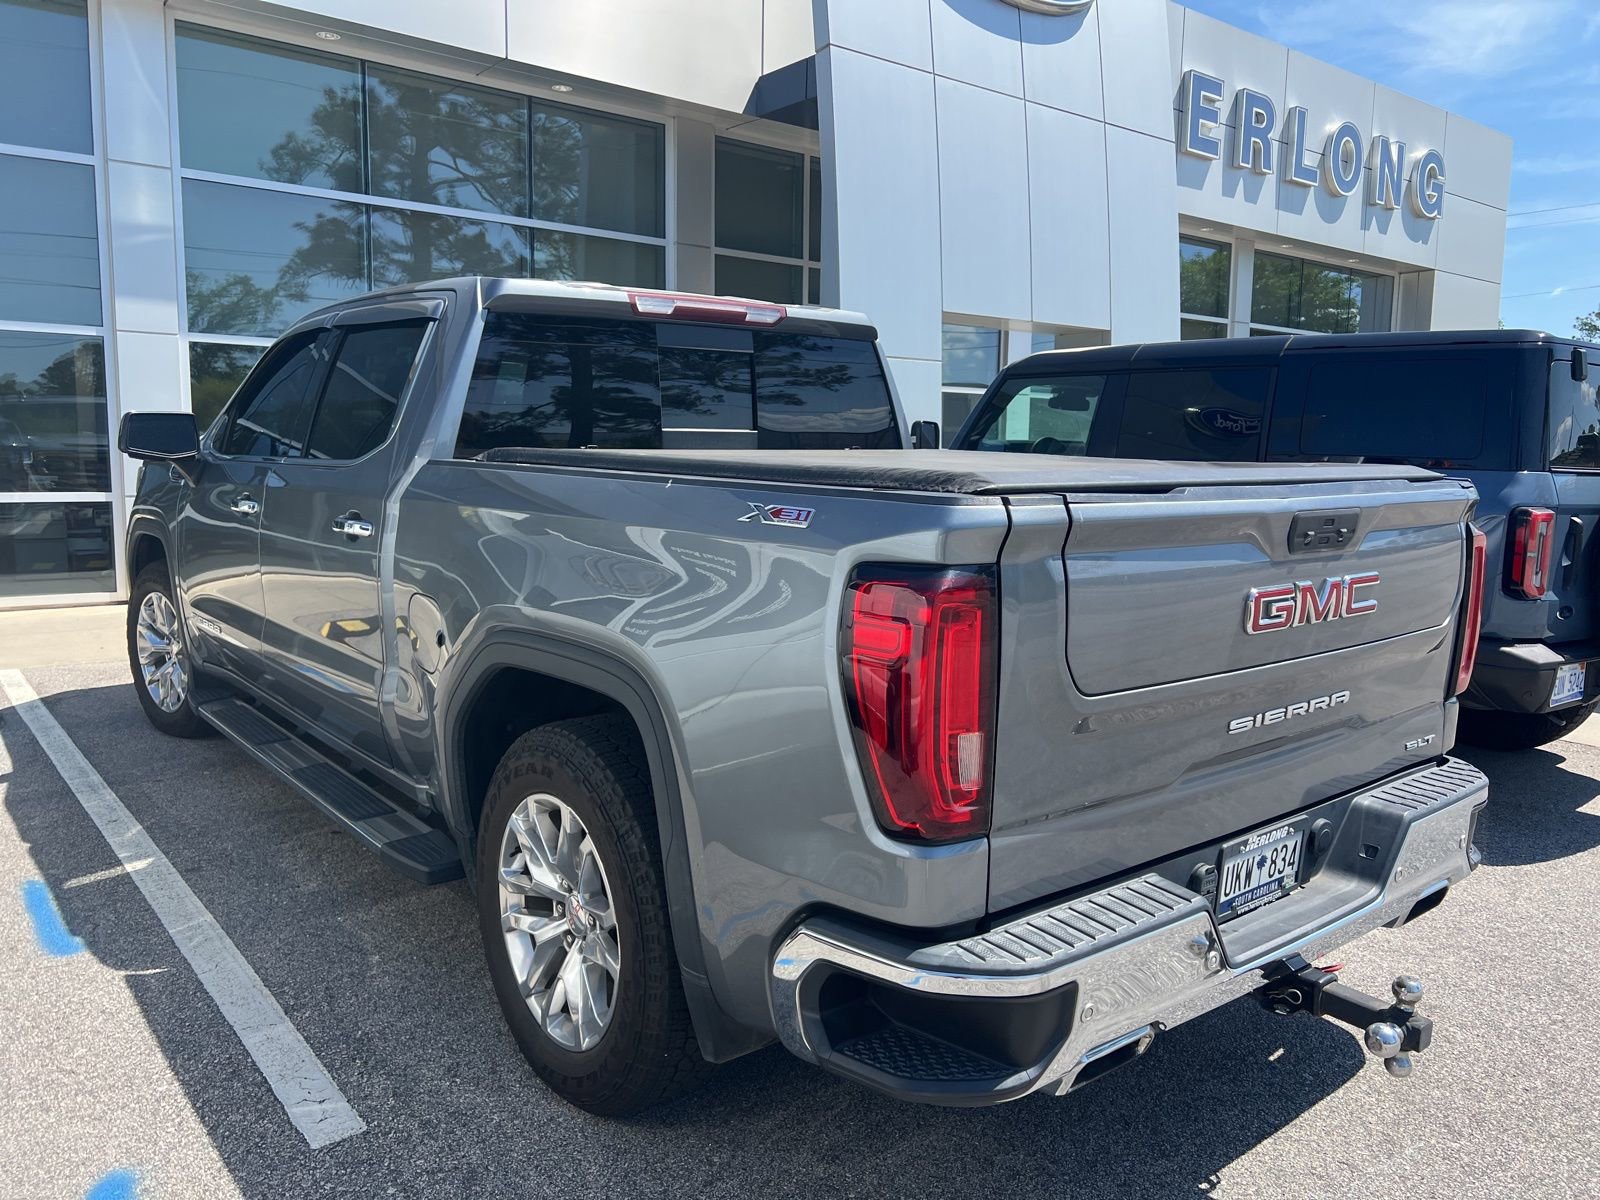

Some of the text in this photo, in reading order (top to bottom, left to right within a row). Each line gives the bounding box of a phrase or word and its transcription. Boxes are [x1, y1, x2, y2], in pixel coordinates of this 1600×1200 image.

[1183, 69, 1446, 219] ERLONG
[1246, 571, 1380, 634] GMC
[1228, 690, 1350, 734] SIERRA
[1405, 735, 1436, 751] SLT
[1246, 826, 1289, 851] HERLONG
[1224, 856, 1255, 897] UKW
[1268, 840, 1298, 878] 834
[1235, 894, 1252, 905] SOUTH
[1253, 881, 1279, 899] CAROLINA
